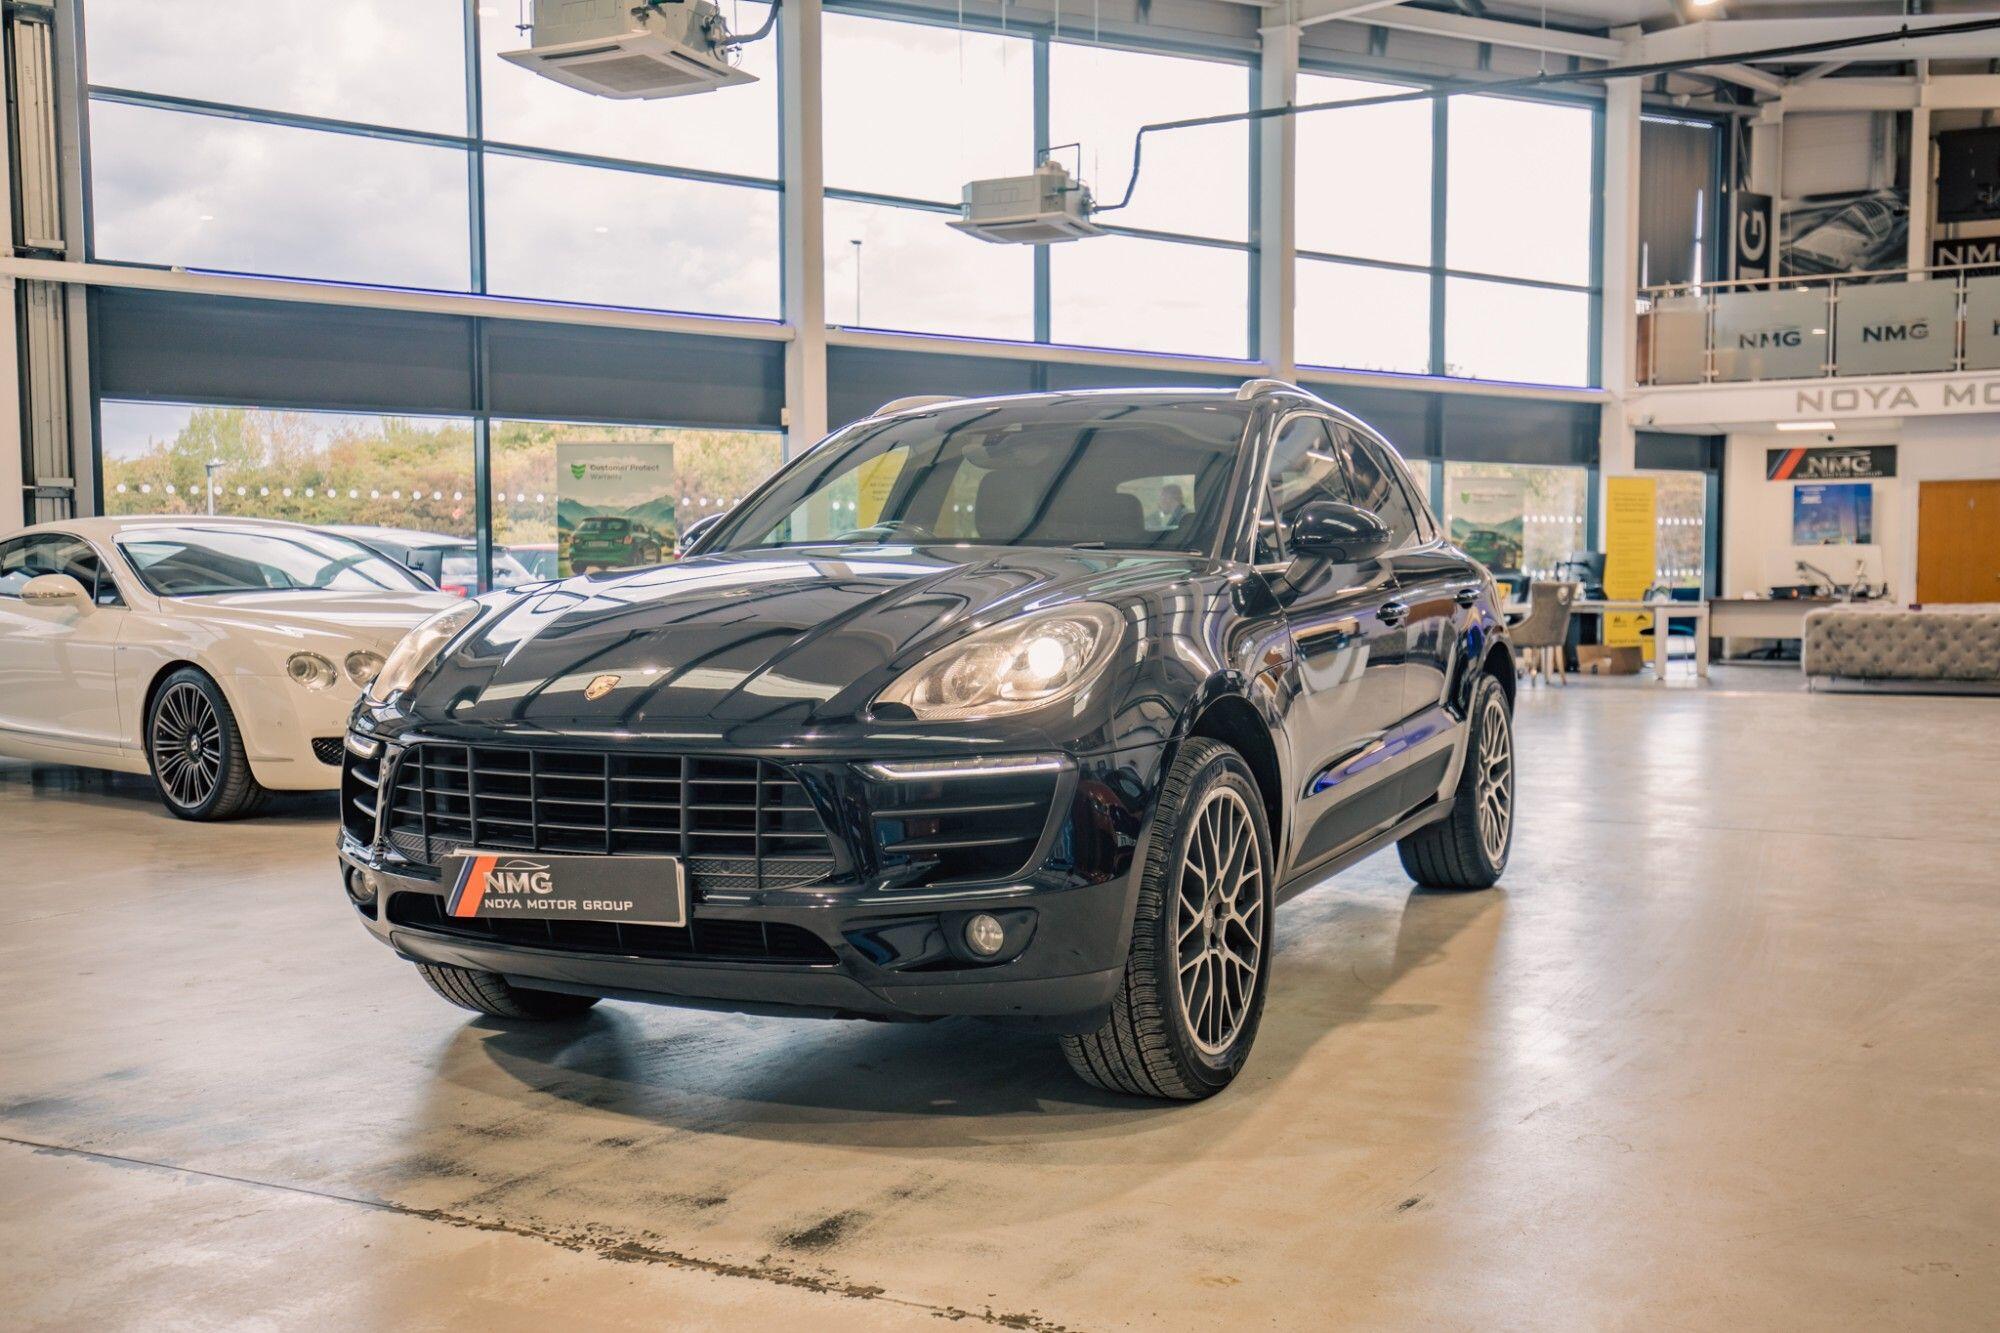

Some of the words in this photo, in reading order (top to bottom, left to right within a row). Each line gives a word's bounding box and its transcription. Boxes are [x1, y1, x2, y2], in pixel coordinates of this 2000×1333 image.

[1739, 331, 1802, 348] NMG
[1862, 323, 1930, 343] NMG
[1796, 386, 1919, 413] NOYA
[630, 463, 659, 472] Protect
[1807, 455, 1872, 474] NMG
[483, 871, 553, 894] NMG
[484, 899, 522, 909] NOYA
[527, 900, 577, 910] MOTOR
[583, 900, 634, 911] GROUP
